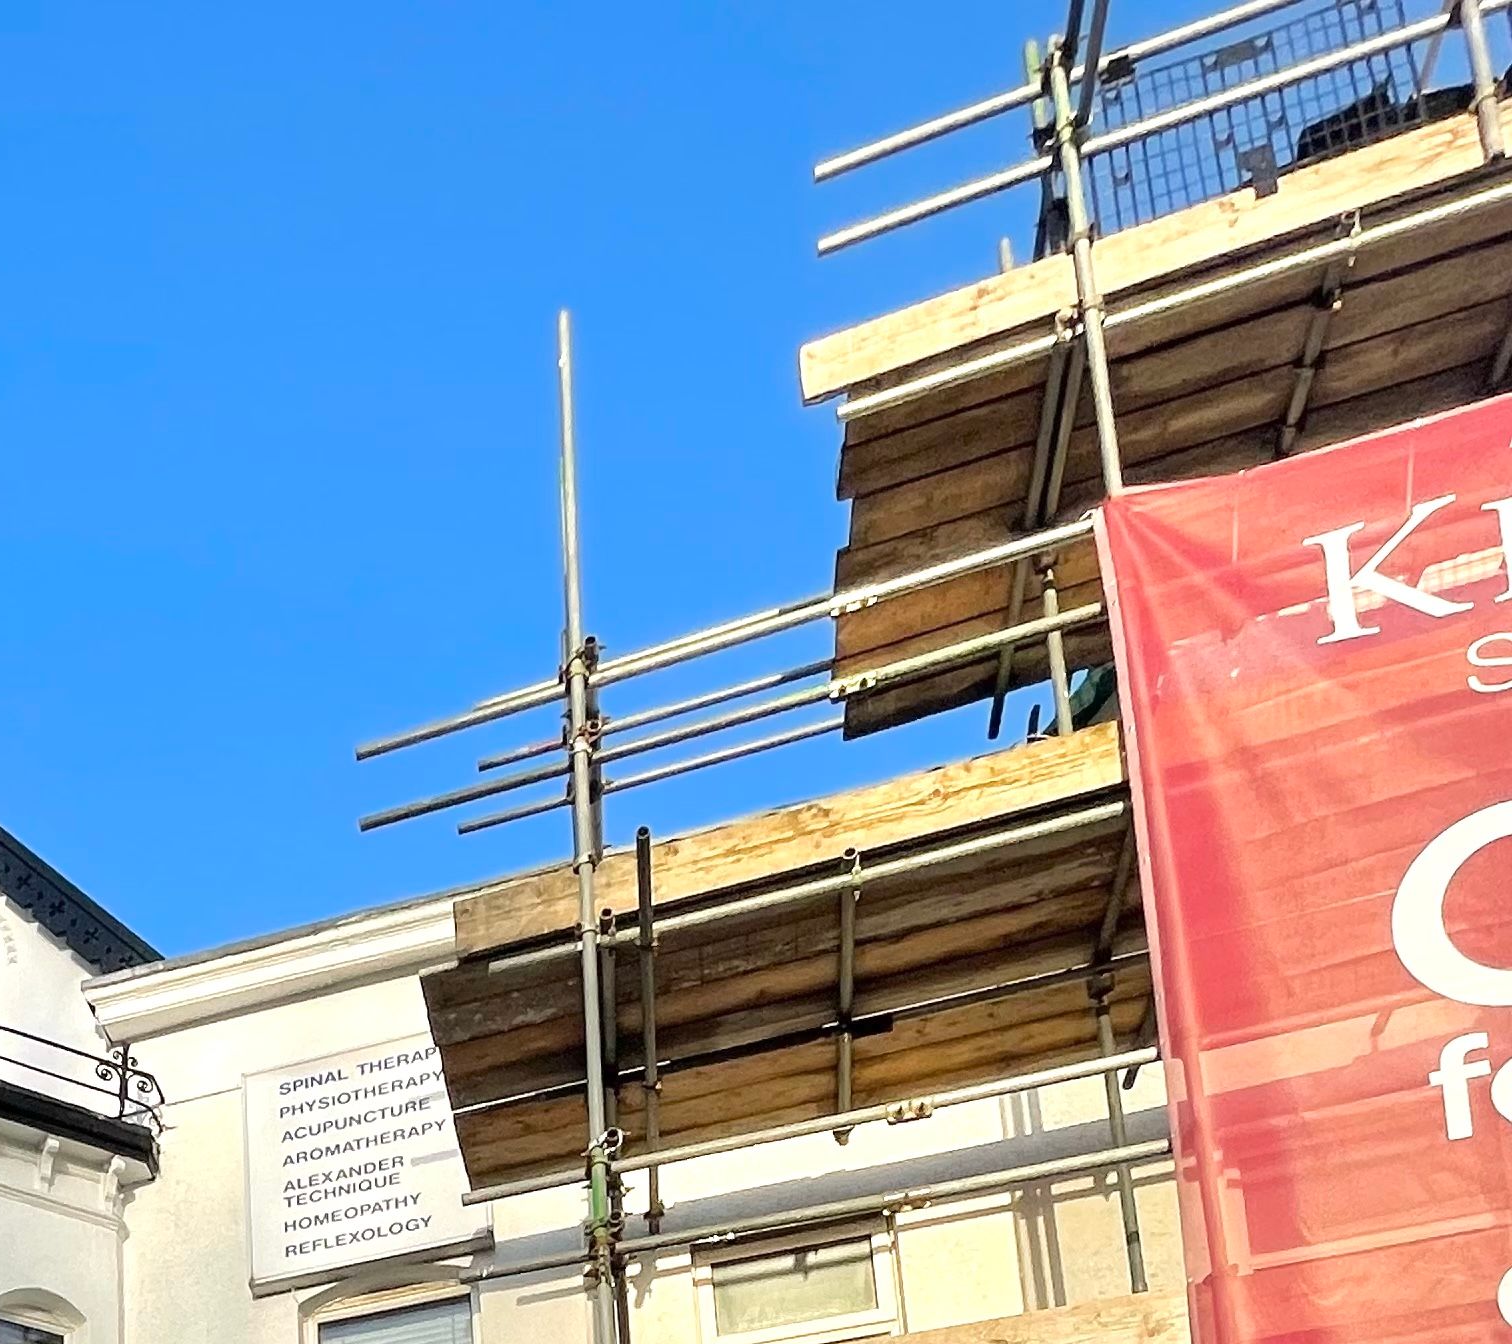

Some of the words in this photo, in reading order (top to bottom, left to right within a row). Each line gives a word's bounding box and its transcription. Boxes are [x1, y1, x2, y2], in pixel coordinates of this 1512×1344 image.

[279, 1069, 349, 1096] SPINAL
[356, 1046, 438, 1077] THERAP
[279, 1069, 444, 1119] PHYSIOTHERAPY
[281, 1097, 431, 1143] ACUPUNCTURE
[282, 1119, 446, 1168] AROMATHERAPY
[283, 1155, 404, 1193] ALEXANDER
[283, 1172, 401, 1208] TECHNIQUE
[284, 1192, 421, 1233] HOMEOPATHY
[285, 1215, 432, 1258] REFLEXOLOGY
